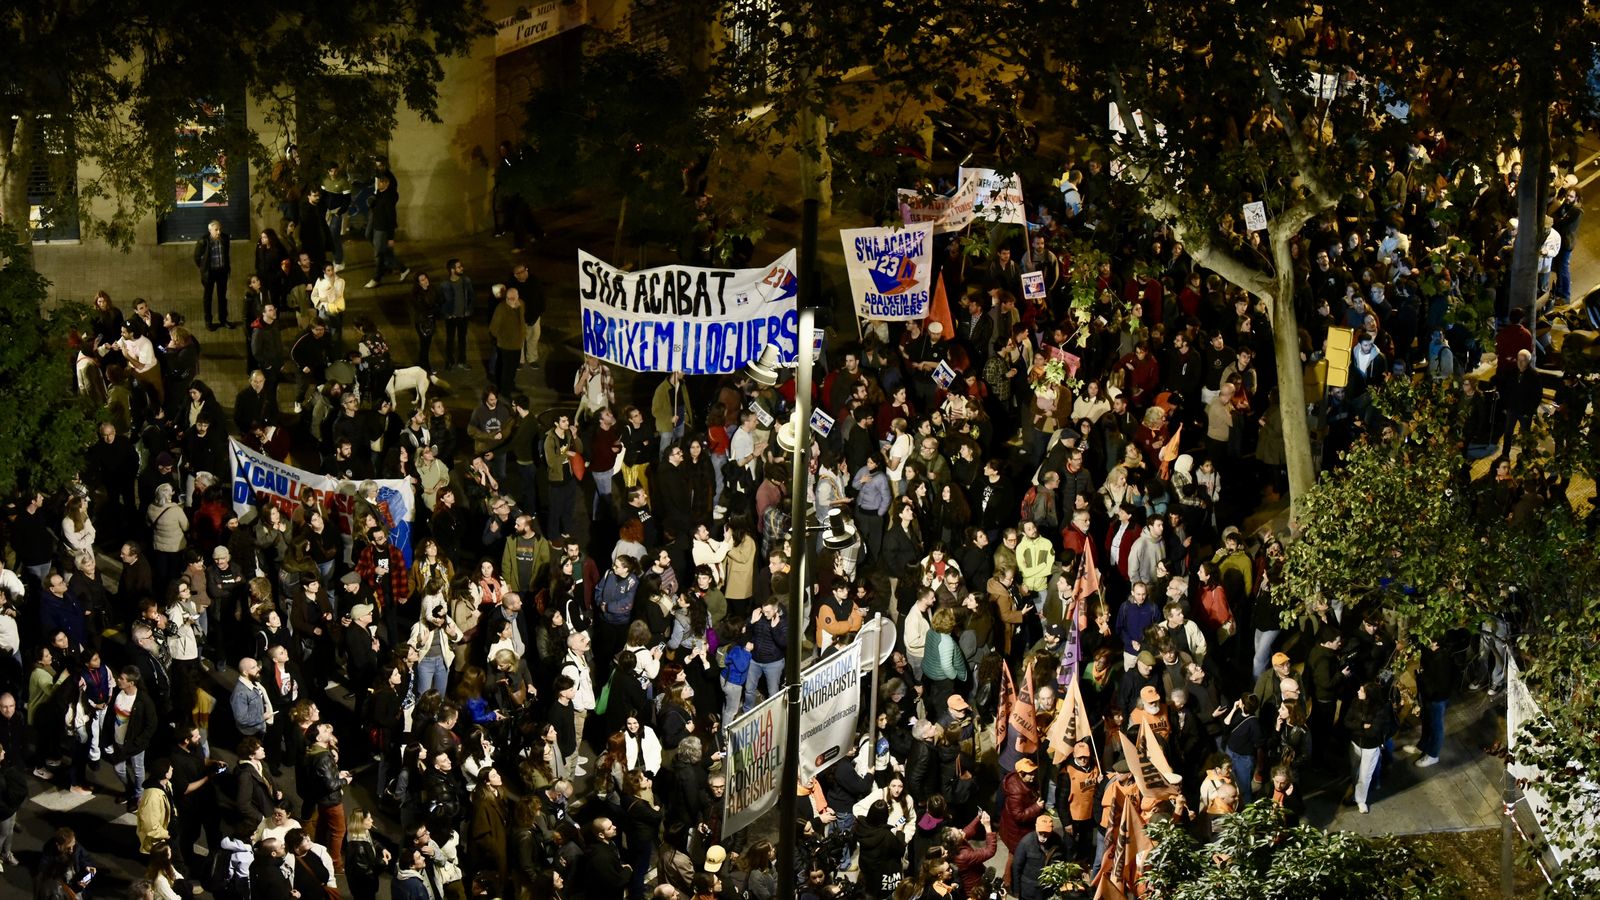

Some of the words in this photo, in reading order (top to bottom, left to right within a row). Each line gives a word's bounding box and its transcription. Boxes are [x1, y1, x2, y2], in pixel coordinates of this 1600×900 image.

[516, 20, 548, 40] l'arca
[633, 270, 735, 317] ACABAT
[864, 292, 909, 306] ABAIXEM
[911, 290, 928, 304] ELS
[870, 302, 923, 316] LLOGUERS
[583, 308, 674, 371] ABAIXEM
[681, 309, 799, 374] LLOGUERS
[252, 465, 288, 496] CAU
[801, 669, 856, 715] ANTIRACISTA
[802, 655, 853, 698] BARCELONA
[759, 709, 773, 737] LA
[729, 755, 769, 794] CONTRA
[728, 771, 777, 818] RACISME
[881, 872, 901, 883] ZUM
